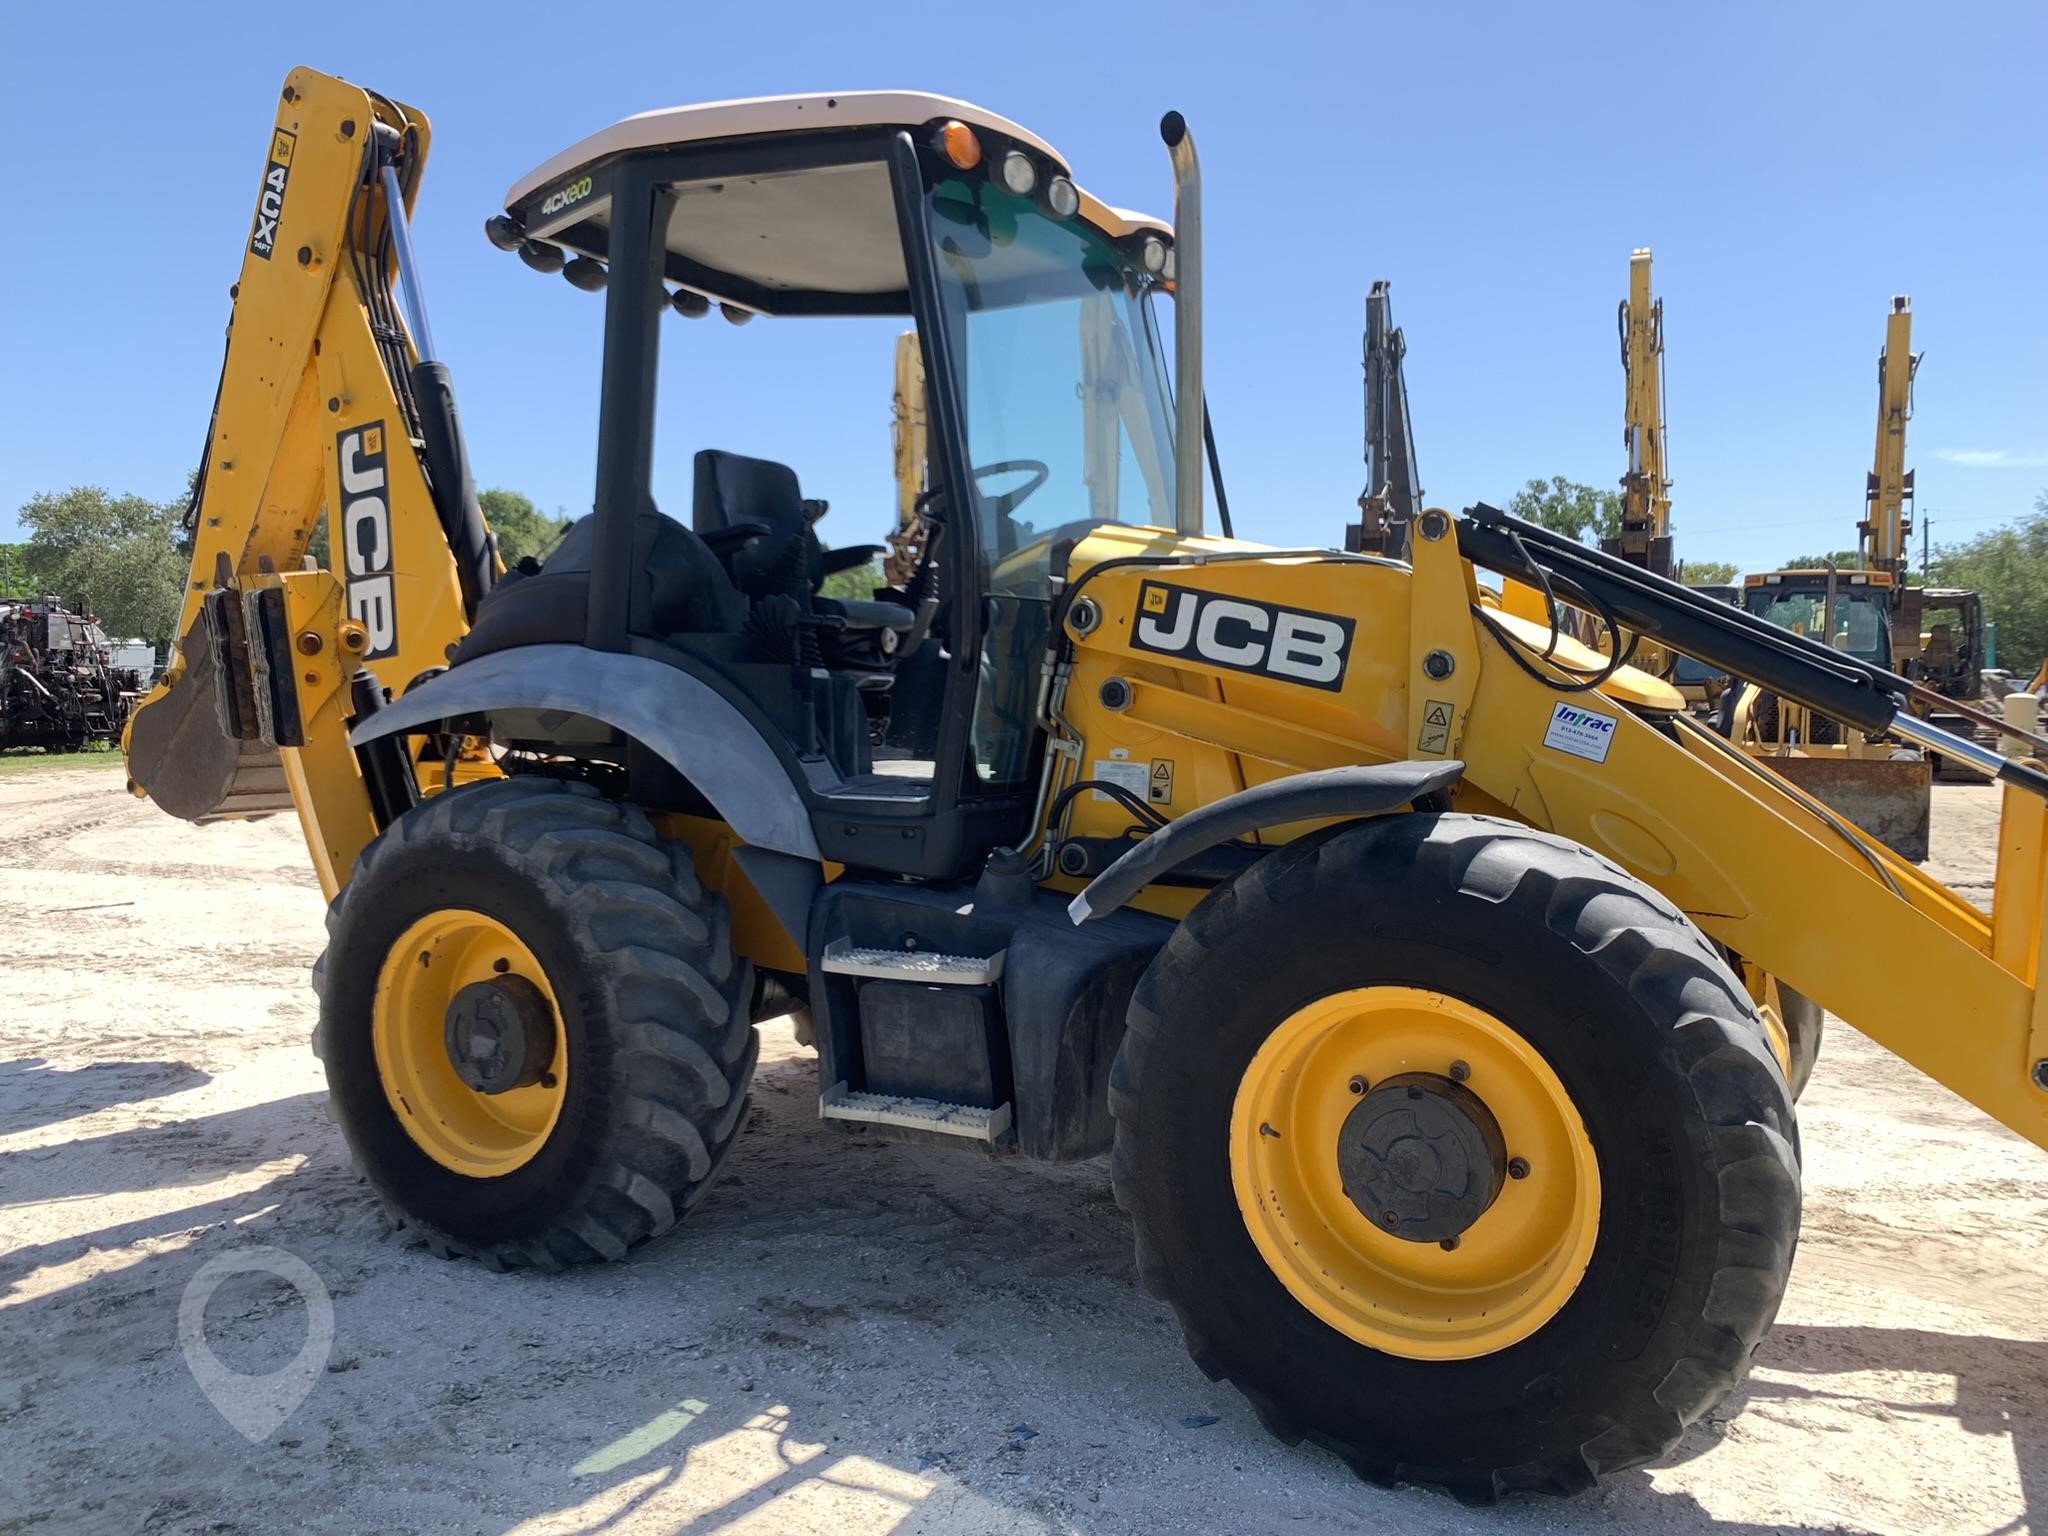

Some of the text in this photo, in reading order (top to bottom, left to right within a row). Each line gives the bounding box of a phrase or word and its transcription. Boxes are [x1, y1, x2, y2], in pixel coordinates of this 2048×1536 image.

[254, 167, 286, 245] 4CX
[541, 176, 592, 215] 4CXeco
[341, 433, 394, 657] JCB
[1138, 592, 1345, 684] JCB
